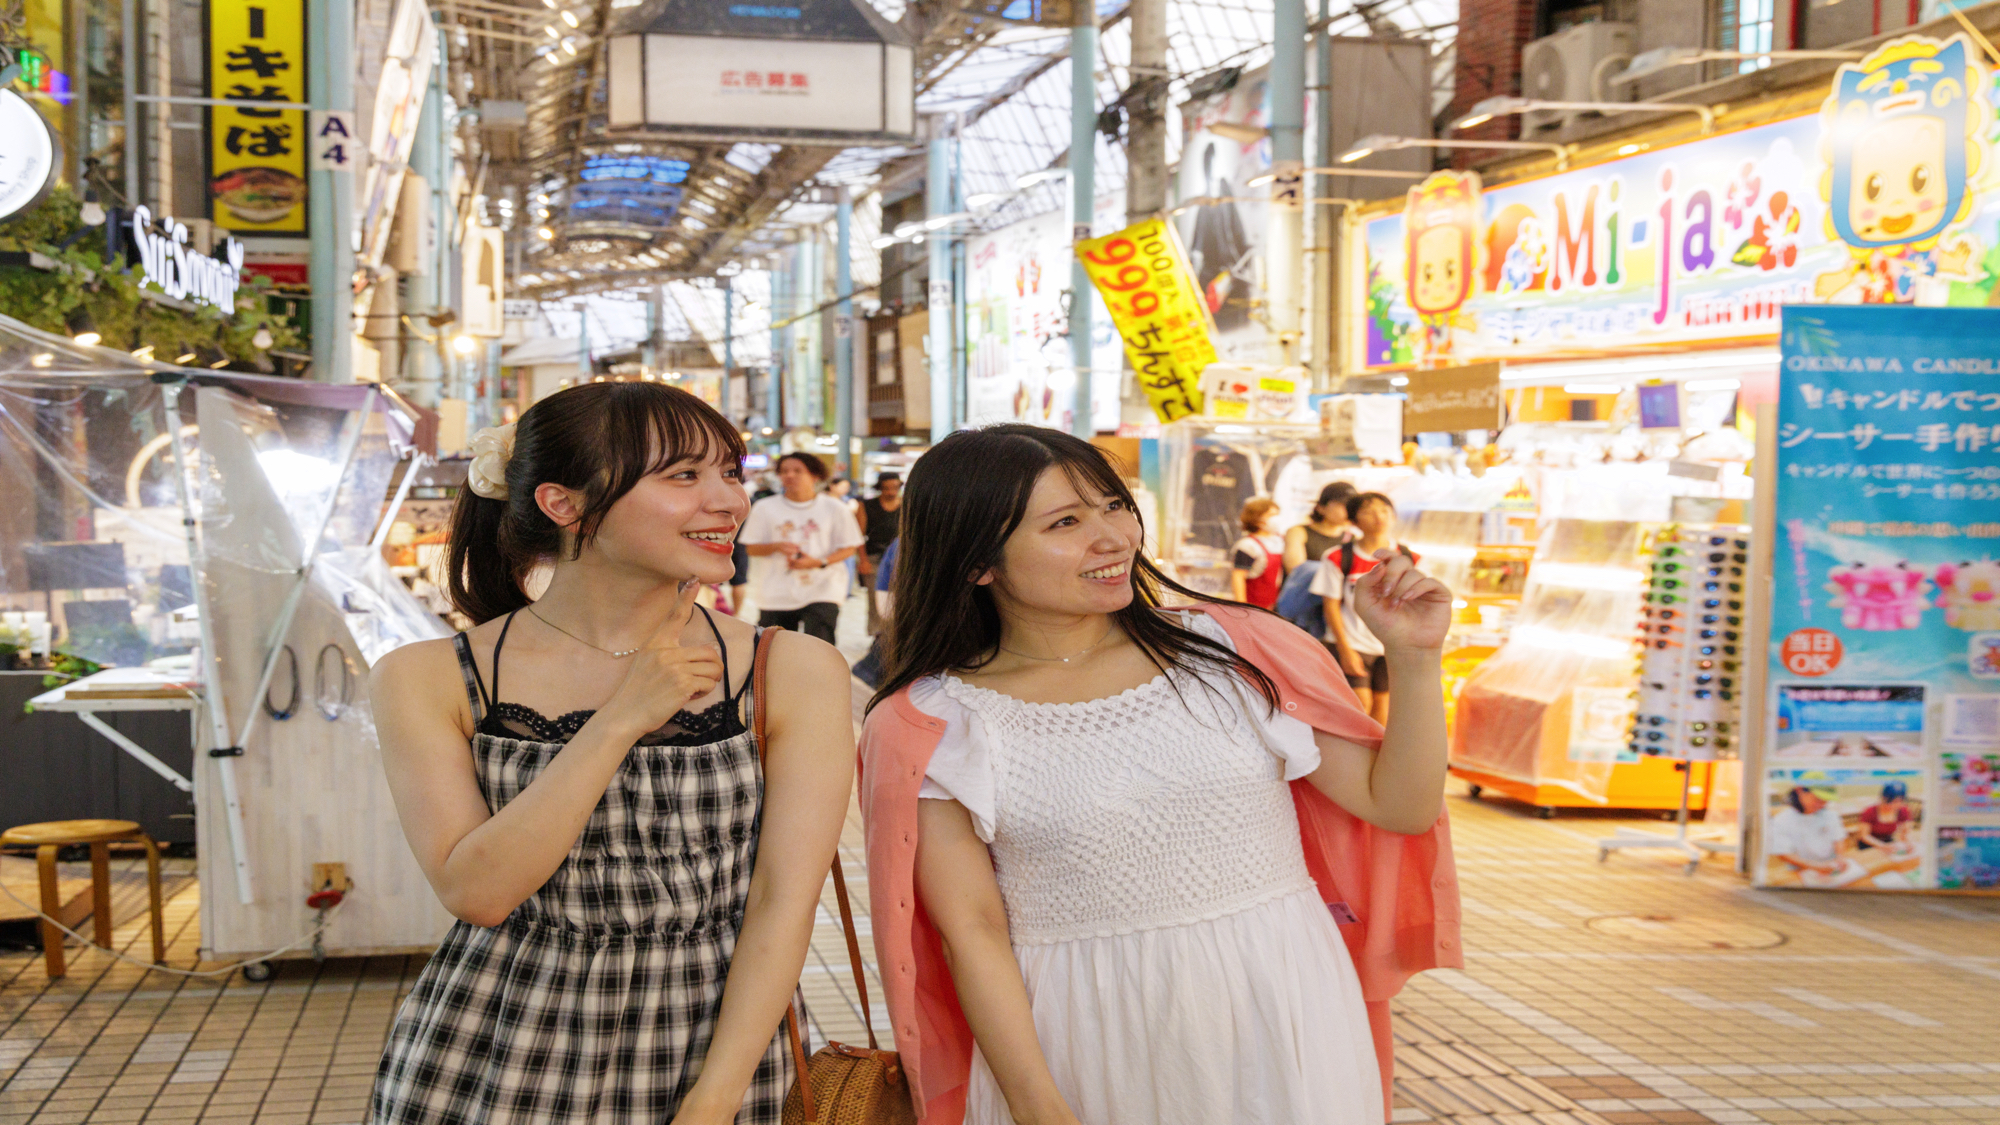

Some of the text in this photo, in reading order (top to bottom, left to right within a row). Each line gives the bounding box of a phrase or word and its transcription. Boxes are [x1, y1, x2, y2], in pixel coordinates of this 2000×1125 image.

[1551, 168, 1715, 324] Mi-ja
[1786, 356, 1903, 373] OKINAWA
[1788, 633, 1835, 652] 当日
[1789, 654, 1832, 673] OK
